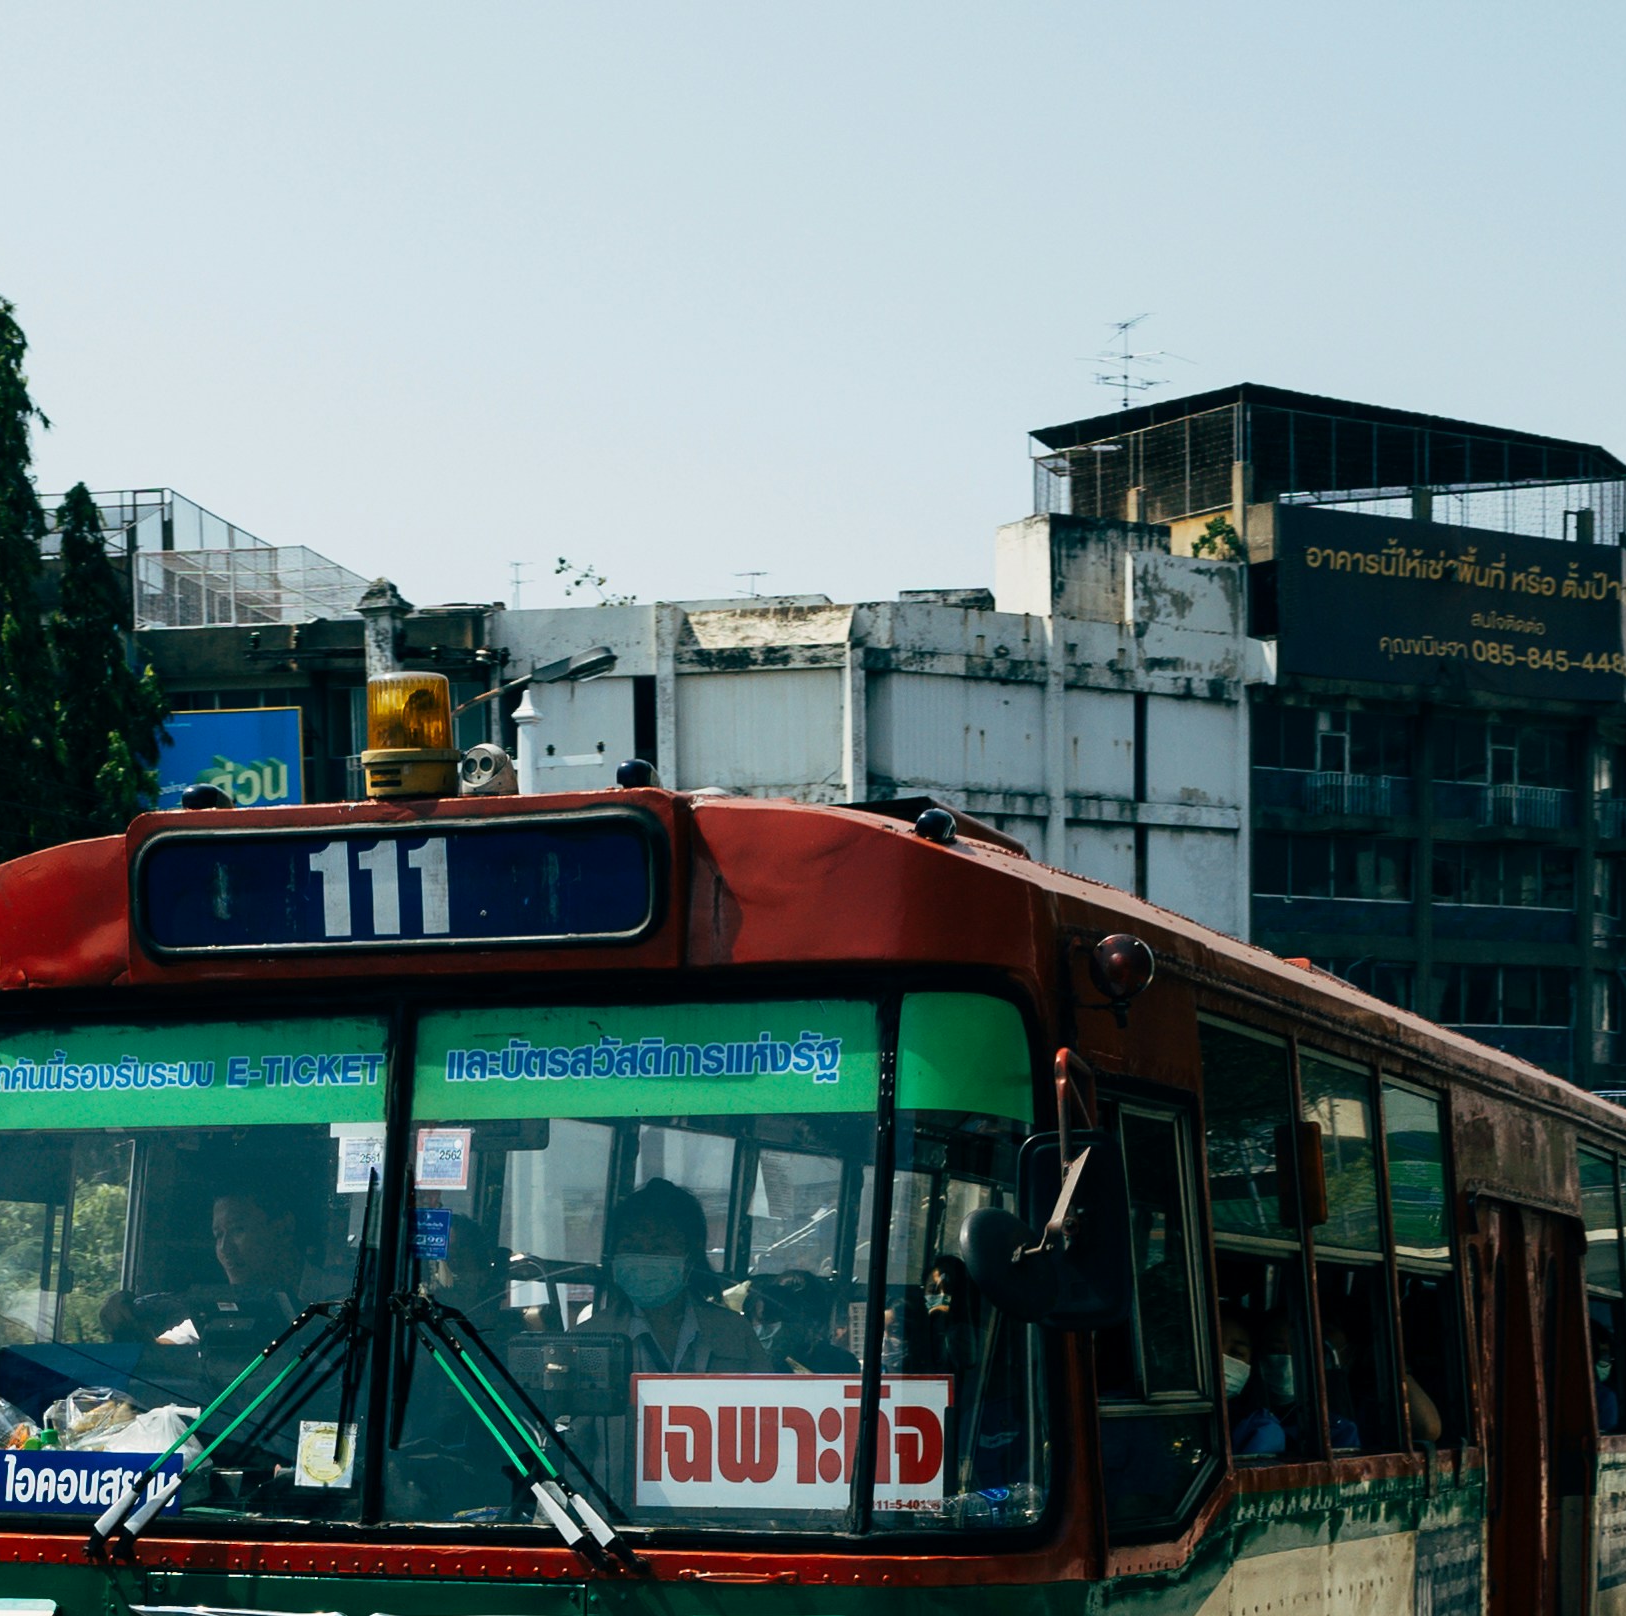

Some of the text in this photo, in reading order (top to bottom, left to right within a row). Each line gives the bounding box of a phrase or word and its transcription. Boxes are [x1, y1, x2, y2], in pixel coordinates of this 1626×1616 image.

[1511, 565, 1557, 597] หรือ
[309, 837, 450, 937] 111
[226, 1053, 385, 1088] E-TICKET
[445, 1031, 843, 1084] และบัตรสวัสดิการแห่งรัฐ
[439, 1150, 462, 1161] 2562
[642, 1384, 944, 1485] เฉพาะกิจ
